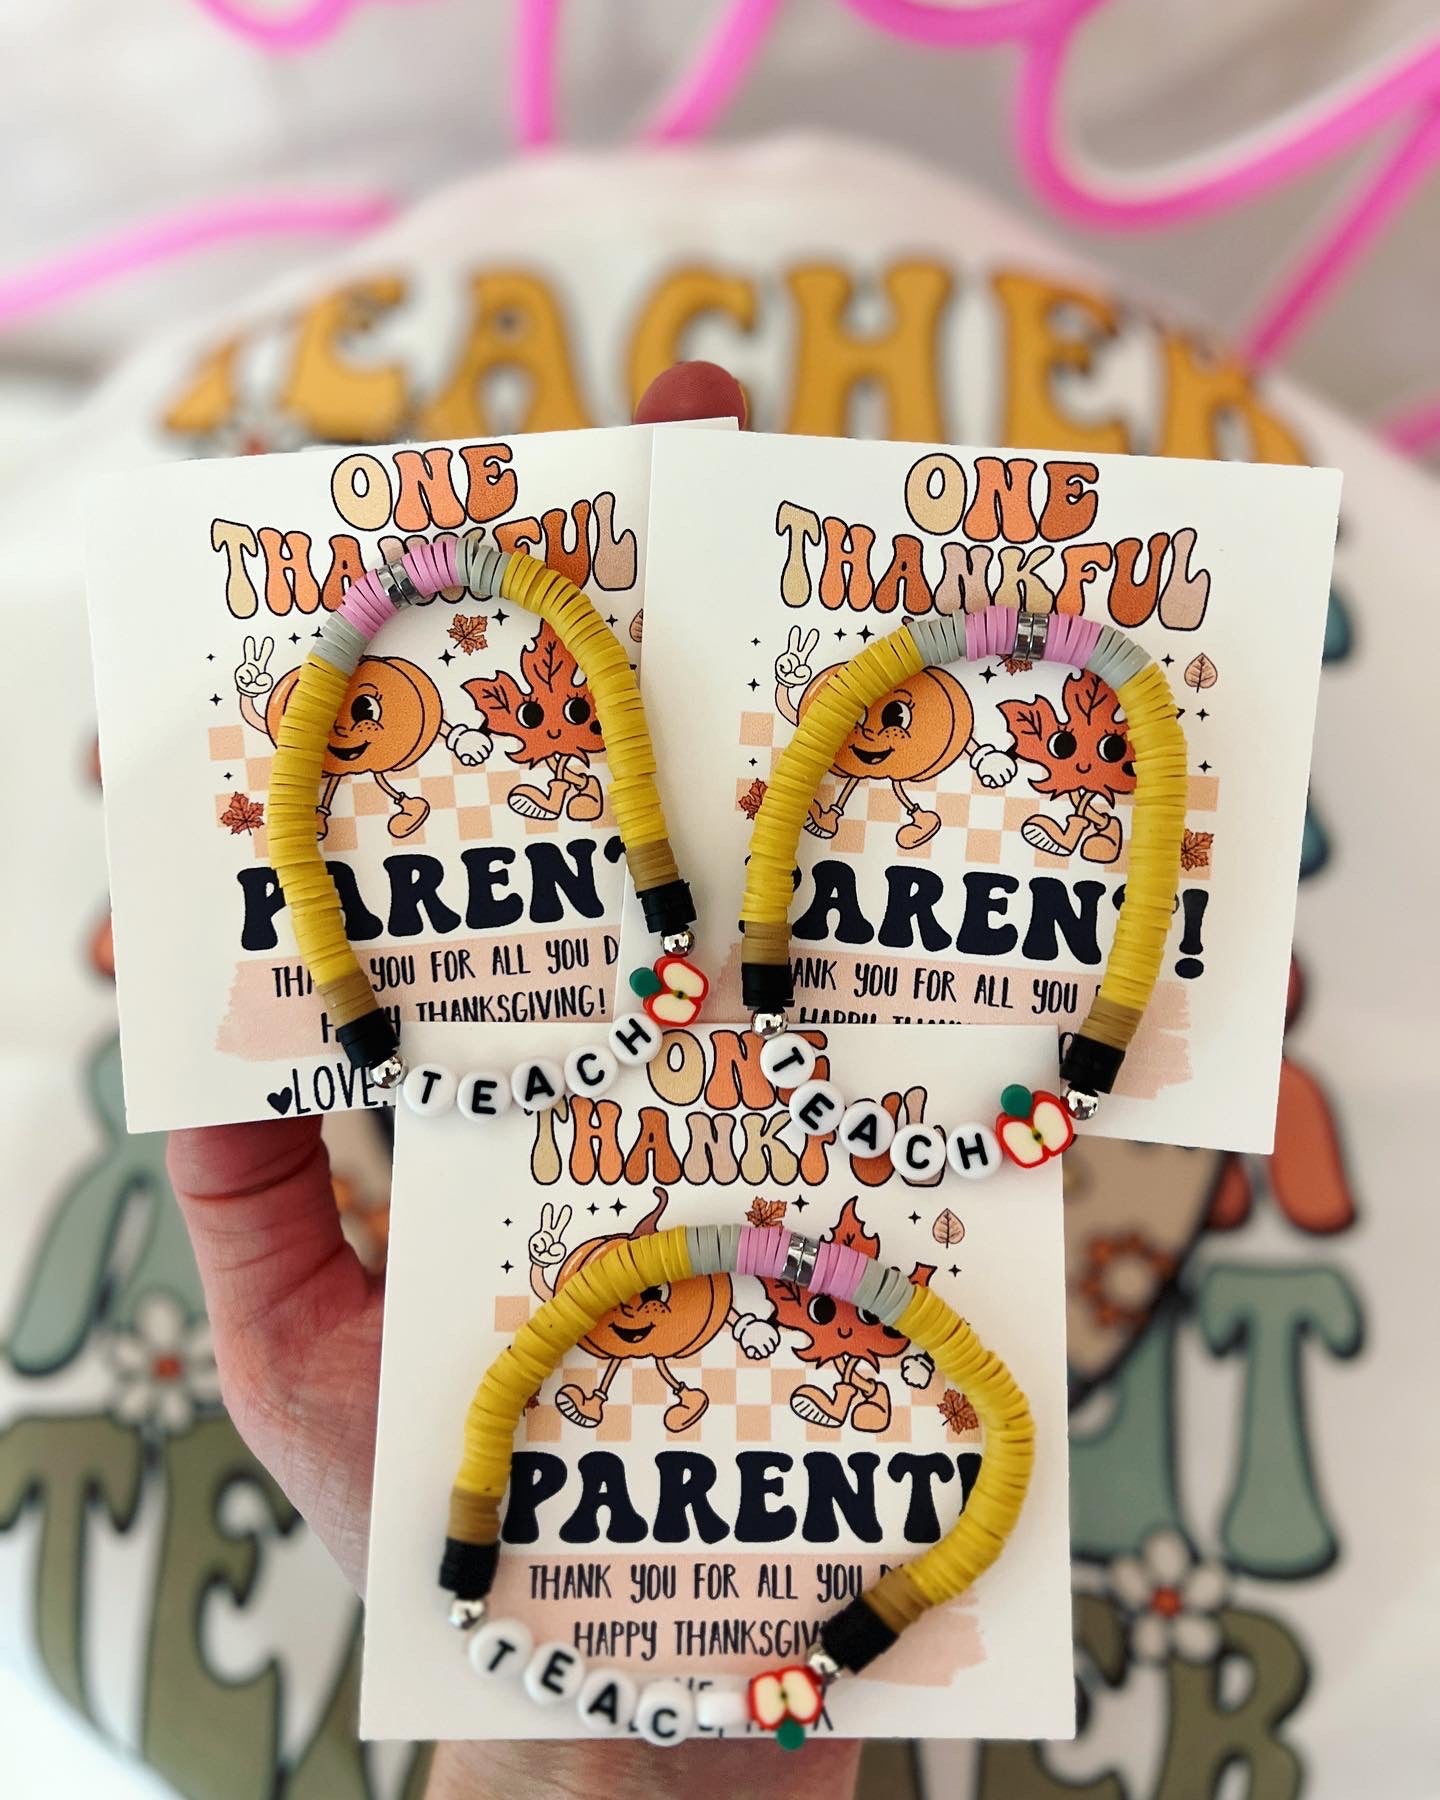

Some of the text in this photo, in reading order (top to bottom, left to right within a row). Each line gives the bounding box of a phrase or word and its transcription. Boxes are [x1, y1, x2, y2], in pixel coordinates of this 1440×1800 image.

[330, 443, 518, 532] ONE
[904, 453, 1099, 543] ONE
[775, 500, 1211, 632] THANKFUL
[370, 955, 416, 993] YOU
[430, 949, 475, 984] FOR
[492, 946, 531, 976] ALL
[547, 939, 590, 973] YOU
[852, 962, 900, 998] YOU
[912, 967, 958, 1004] FOR
[973, 974, 1014, 1009] ALL
[1031, 979, 1079, 1014] YOU
[418, 1016, 653, 1116] TEACH
[773, 1045, 989, 1170] TEACH
[528, 1563, 612, 1600] THANK
[629, 1564, 677, 1603] YOU
[694, 1563, 740, 1600] FOR
[757, 1564, 799, 1600] ALL
[816, 1563, 863, 1603] YOU
[572, 1620, 657, 1661] HAPPY
